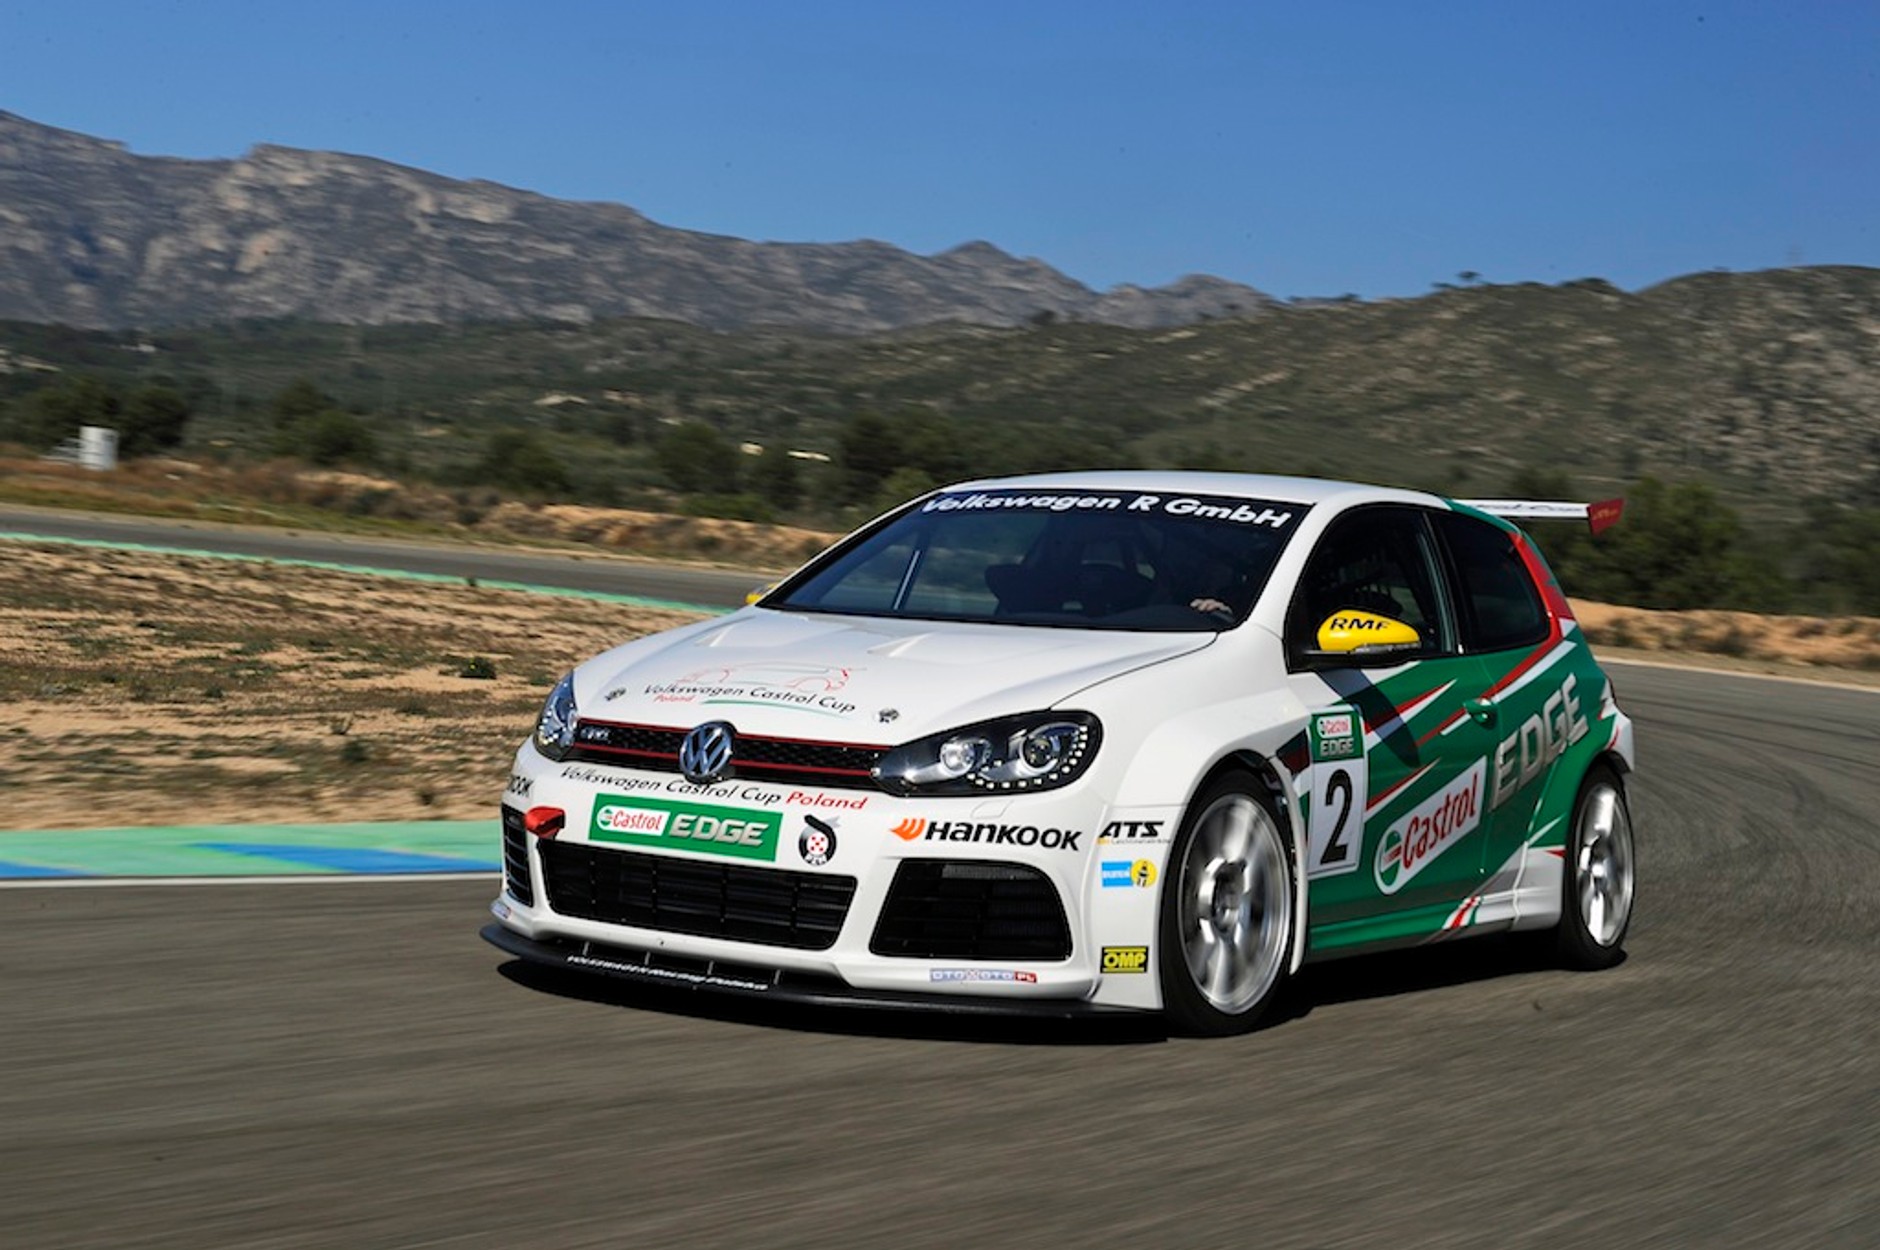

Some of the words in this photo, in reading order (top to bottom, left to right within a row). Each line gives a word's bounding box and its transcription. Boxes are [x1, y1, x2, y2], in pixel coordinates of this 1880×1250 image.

[921, 494, 1126, 512] Volkswagen
[1128, 495, 1160, 512] R
[1164, 495, 1292, 528] GmbH
[1330, 617, 1391, 630] RMF
[644, 684, 744, 697] Volkswagen
[750, 687, 813, 704] Castrol
[818, 696, 856, 713] Cup
[1320, 738, 1355, 757] EDGE
[1402, 770, 1478, 870] Castrol
[1488, 672, 1589, 814] EDGE
[560, 766, 661, 791] Volkswagen
[666, 779, 737, 799] Castrol
[741, 786, 781, 804] Cup
[786, 790, 868, 810] Poland
[612, 810, 663, 831] Castrol
[669, 813, 769, 847] EDGE
[1099, 821, 1165, 838] ATS
[1319, 768, 1353, 865] 2
[1103, 952, 1147, 968] OMP
